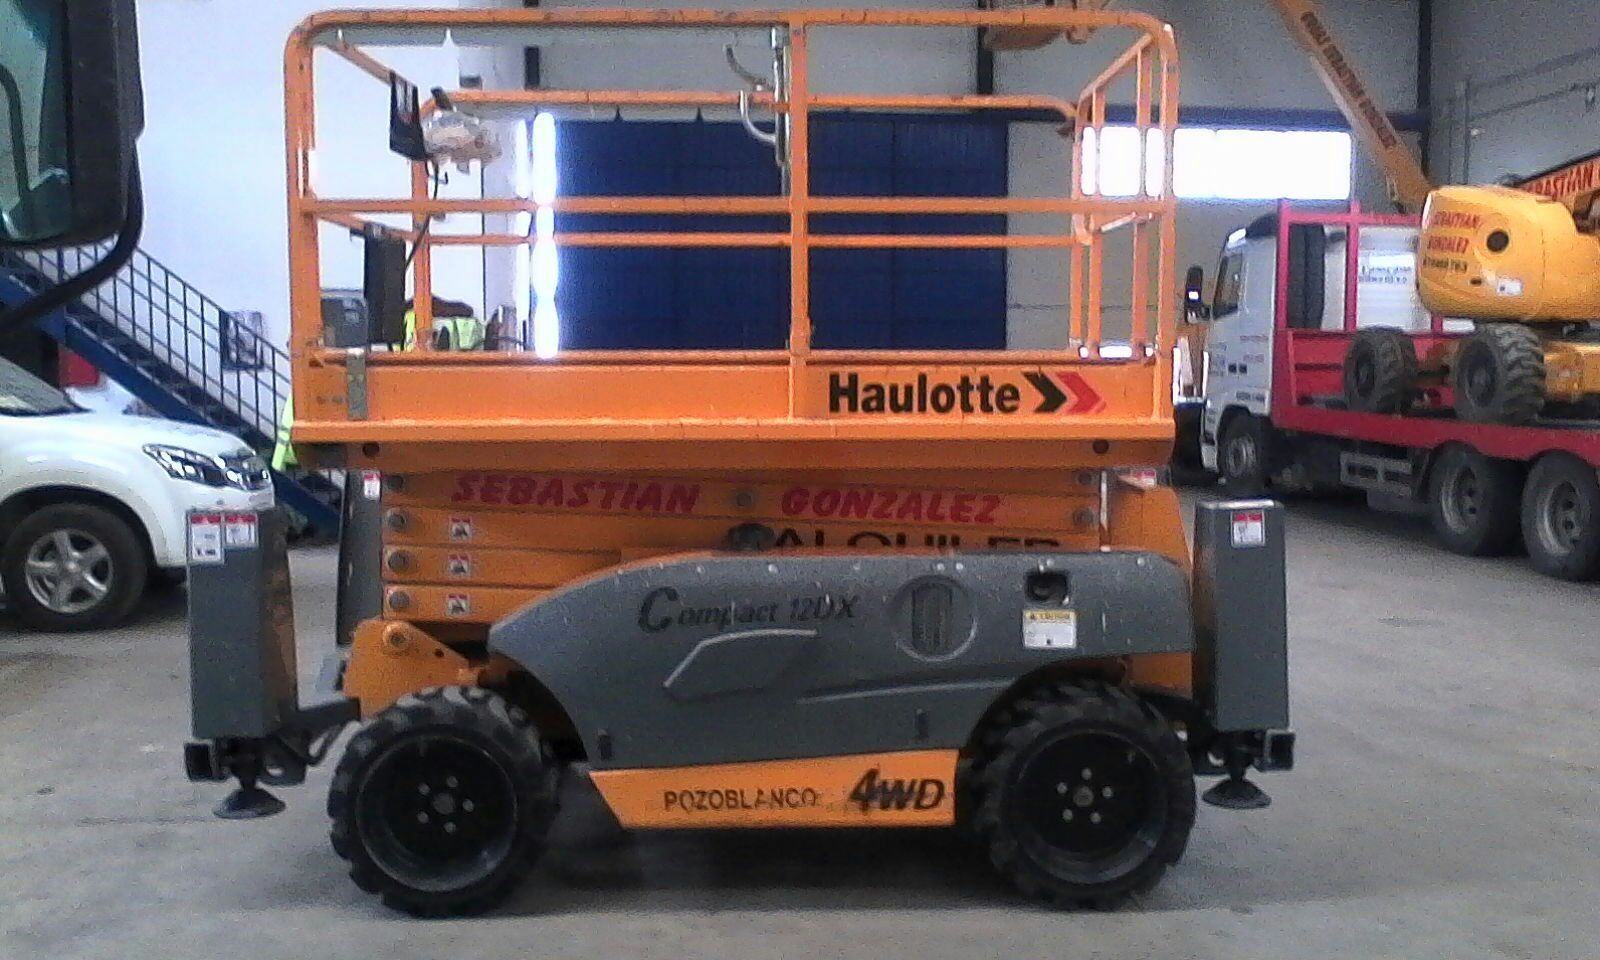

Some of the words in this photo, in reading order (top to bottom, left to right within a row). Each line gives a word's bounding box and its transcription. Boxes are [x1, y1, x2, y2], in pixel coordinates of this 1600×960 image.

[829, 371, 1020, 413] Haulotte
[450, 473, 701, 513] SEBASTIAN
[781, 487, 1001, 524] GONZALEZ
[638, 586, 779, 633] Compact
[663, 786, 818, 812] POZOBLANCO
[847, 767, 946, 814] 4WD
